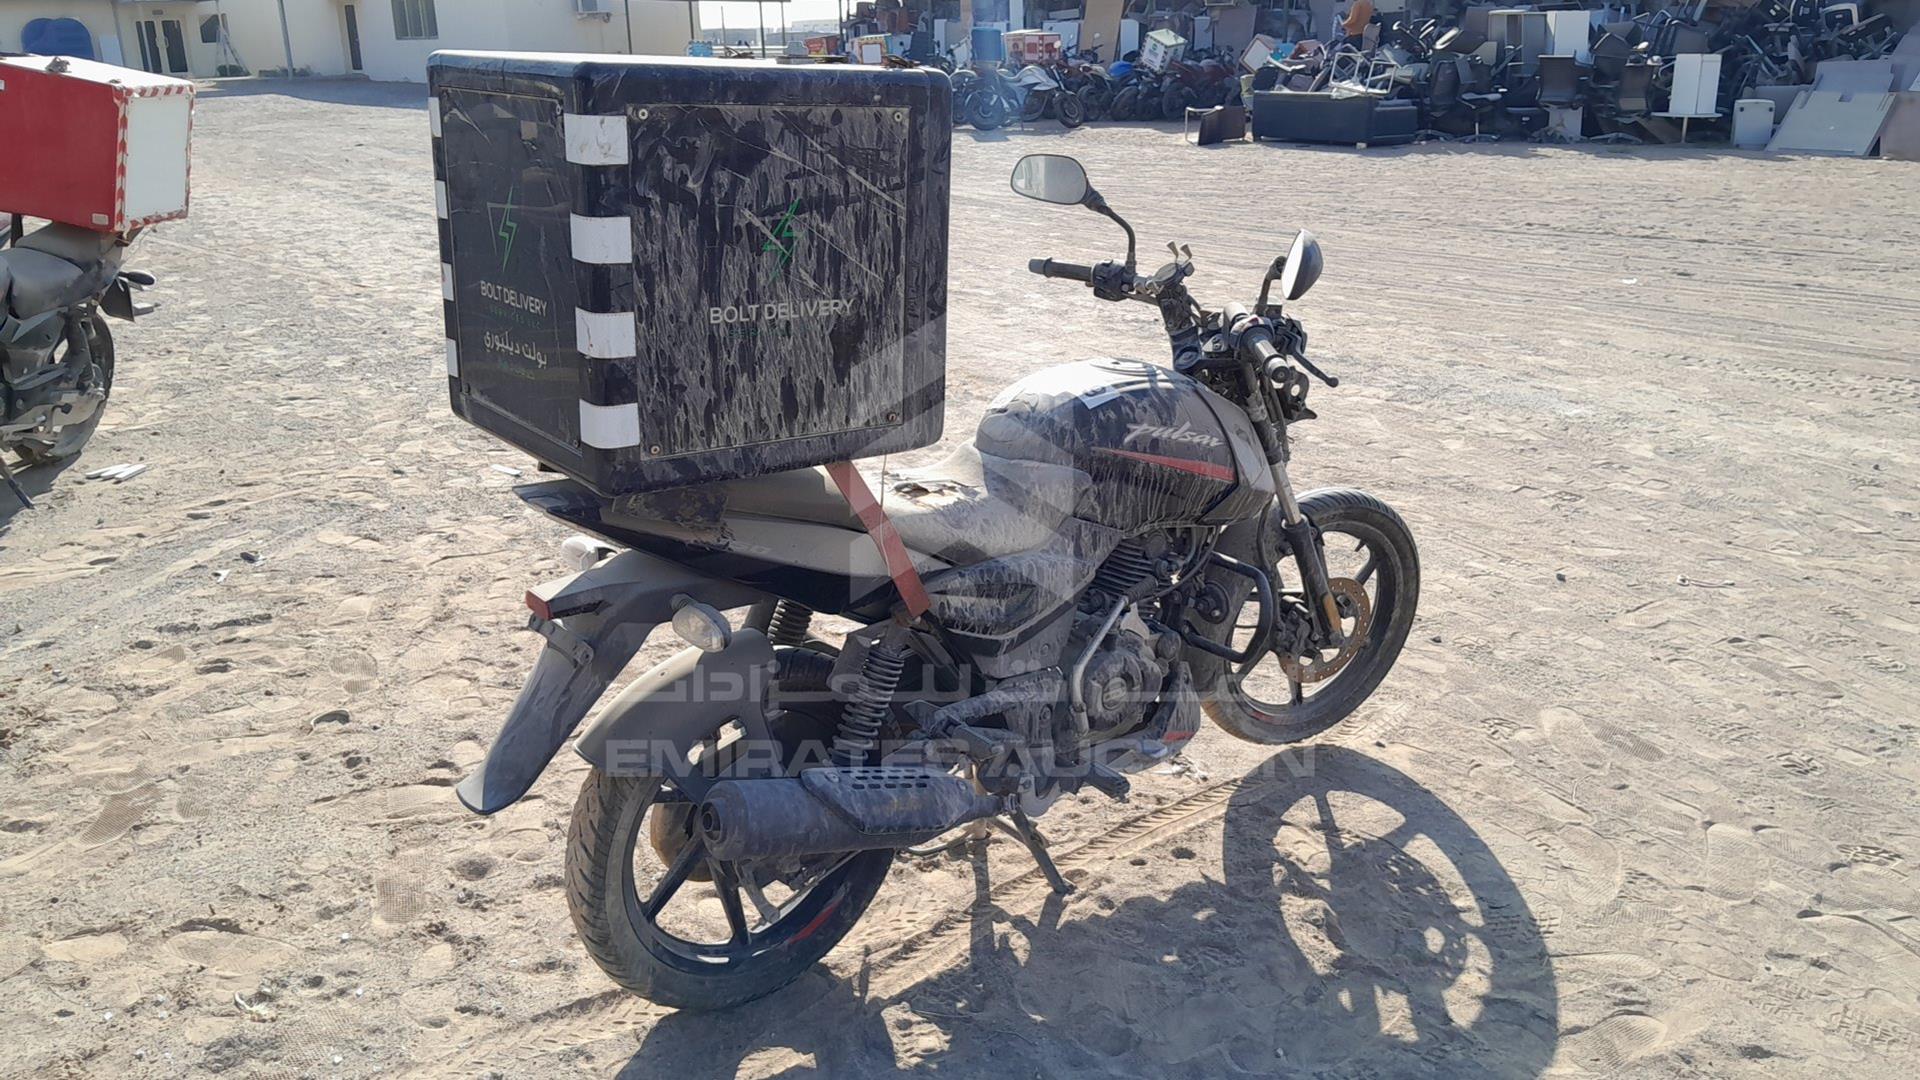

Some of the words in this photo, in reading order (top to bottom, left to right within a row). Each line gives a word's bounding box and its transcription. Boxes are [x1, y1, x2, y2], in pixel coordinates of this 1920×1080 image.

[480, 280, 502, 301] BOLT
[503, 287, 547, 317] DELIVERY
[710, 305, 760, 324] BOLT
[765, 299, 854, 320] DELIVERY
[522, 342, 547, 370] بولت
